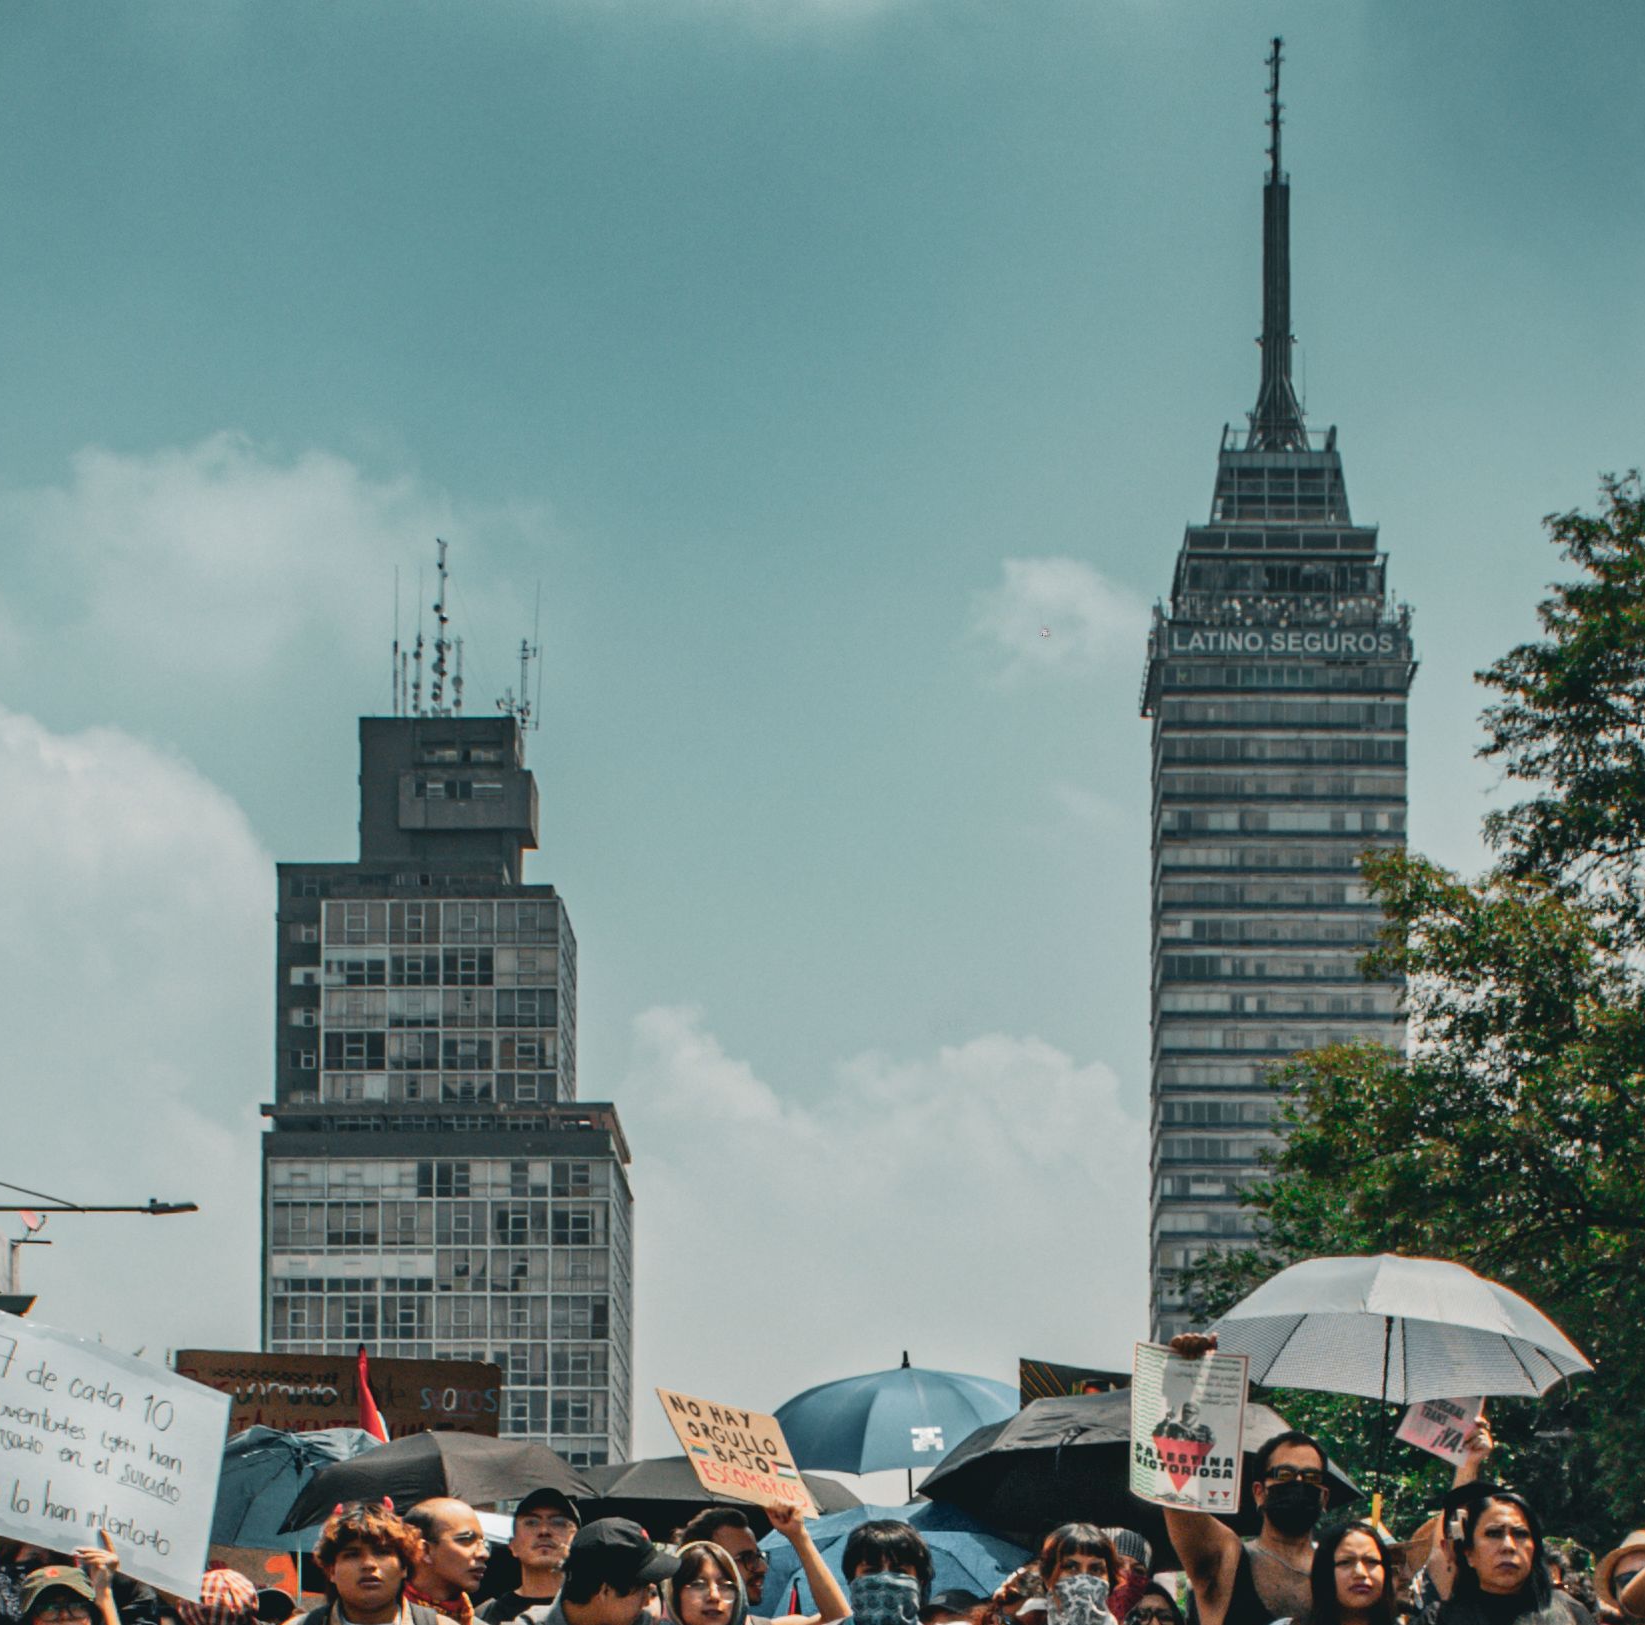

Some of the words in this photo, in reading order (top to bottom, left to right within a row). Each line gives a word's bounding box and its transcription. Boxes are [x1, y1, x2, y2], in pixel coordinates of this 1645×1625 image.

[1173, 631, 1263, 653] LATINO
[1270, 631, 1394, 654] SEGUROS
[26, 1360, 58, 1392] de
[68, 1377, 124, 1412] cada
[144, 1393, 175, 1432] 10
[668, 1395, 701, 1418] NO
[709, 1405, 750, 1429] HAY
[687, 1421, 778, 1456] ORGULLO
[1135, 1442, 1234, 1468] PALESTINA
[59, 1446, 85, 1469] en
[94, 1457, 111, 1476] el
[149, 1442, 183, 1475] han
[711, 1443, 771, 1474] BAJO
[1135, 1453, 1234, 1480] VICTORIOSA
[698, 1459, 808, 1508] ESCOMBROS
[10, 1478, 31, 1515] lo
[42, 1478, 77, 1523] han
